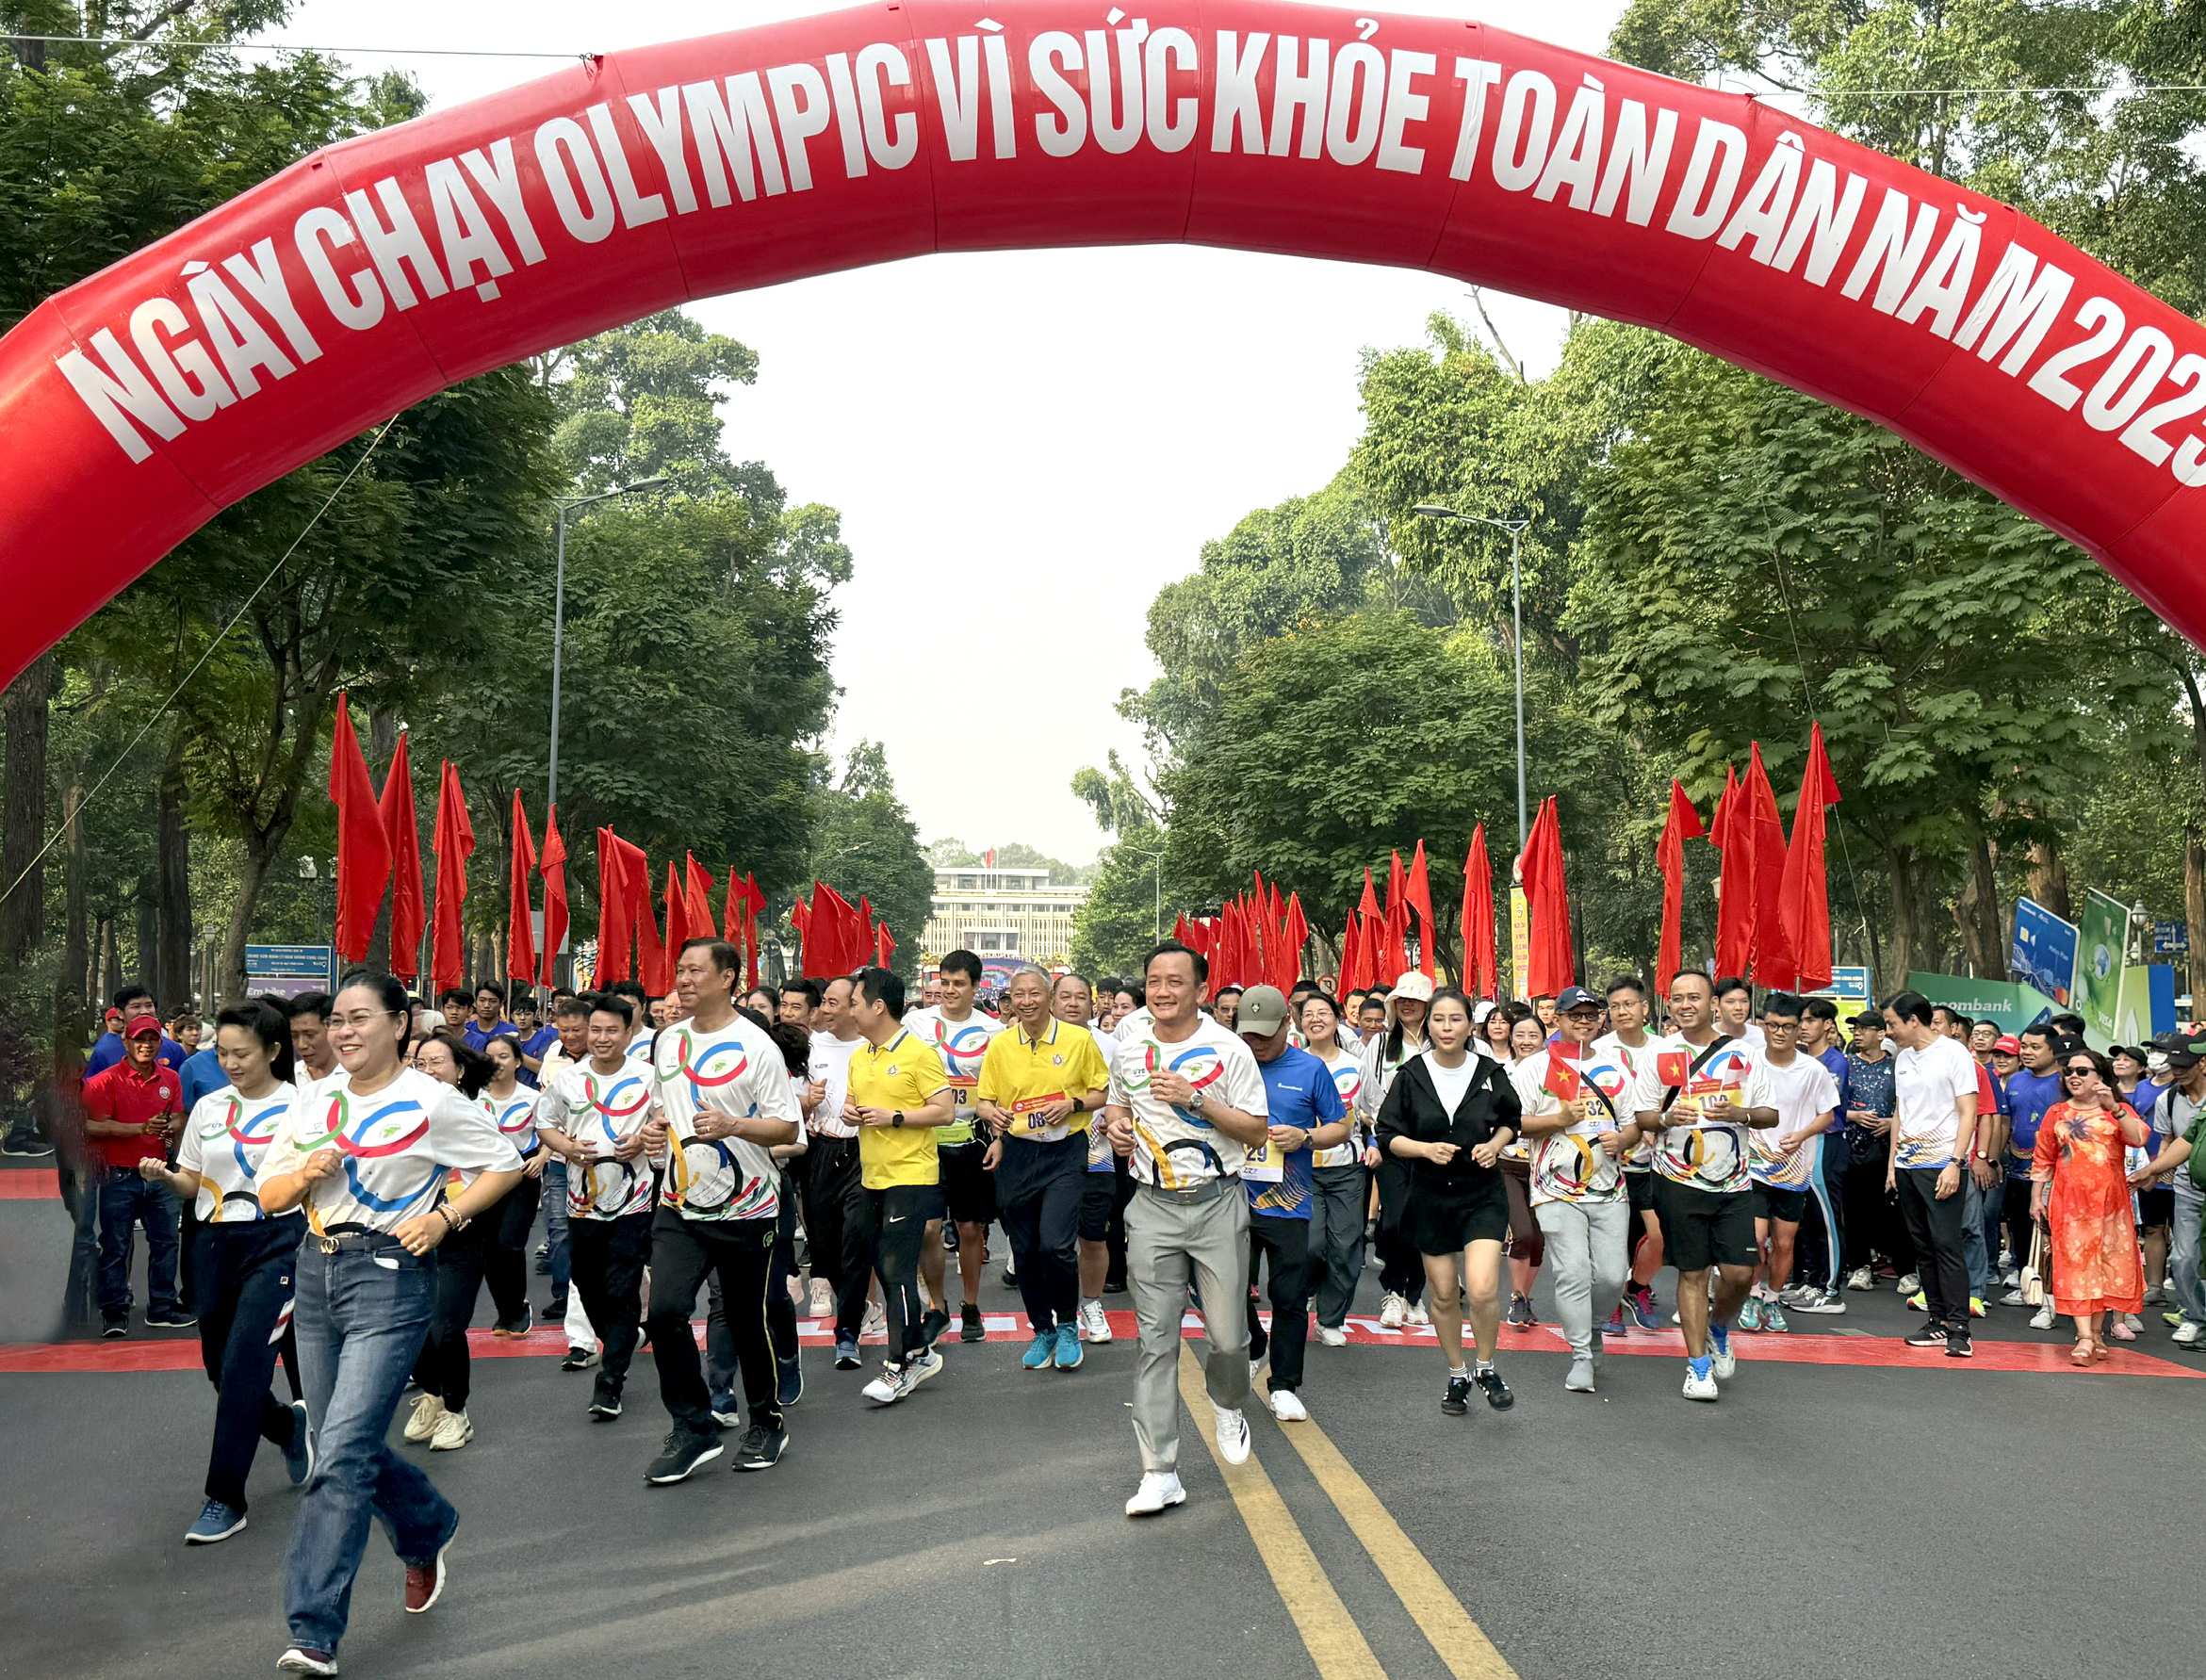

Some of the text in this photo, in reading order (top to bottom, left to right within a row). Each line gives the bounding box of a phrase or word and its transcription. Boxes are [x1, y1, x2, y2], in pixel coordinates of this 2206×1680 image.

[54, 261, 324, 465] NGÀY
[294, 137, 547, 330] CHẠY
[533, 42, 918, 243] OLYMPIC
[923, 17, 1016, 161] VÌ
[1027, 6, 1199, 157] SỨC
[1211, 17, 1437, 175] KHỎE
[1448, 57, 1678, 227] TOÀN
[1664, 115, 1872, 287] DÂN
[1840, 187, 2075, 377] NĂM
[1586, 1101, 1605, 1116] 32
[1028, 1112, 1045, 1129] 08
[1247, 1143, 1268, 1163] 29
